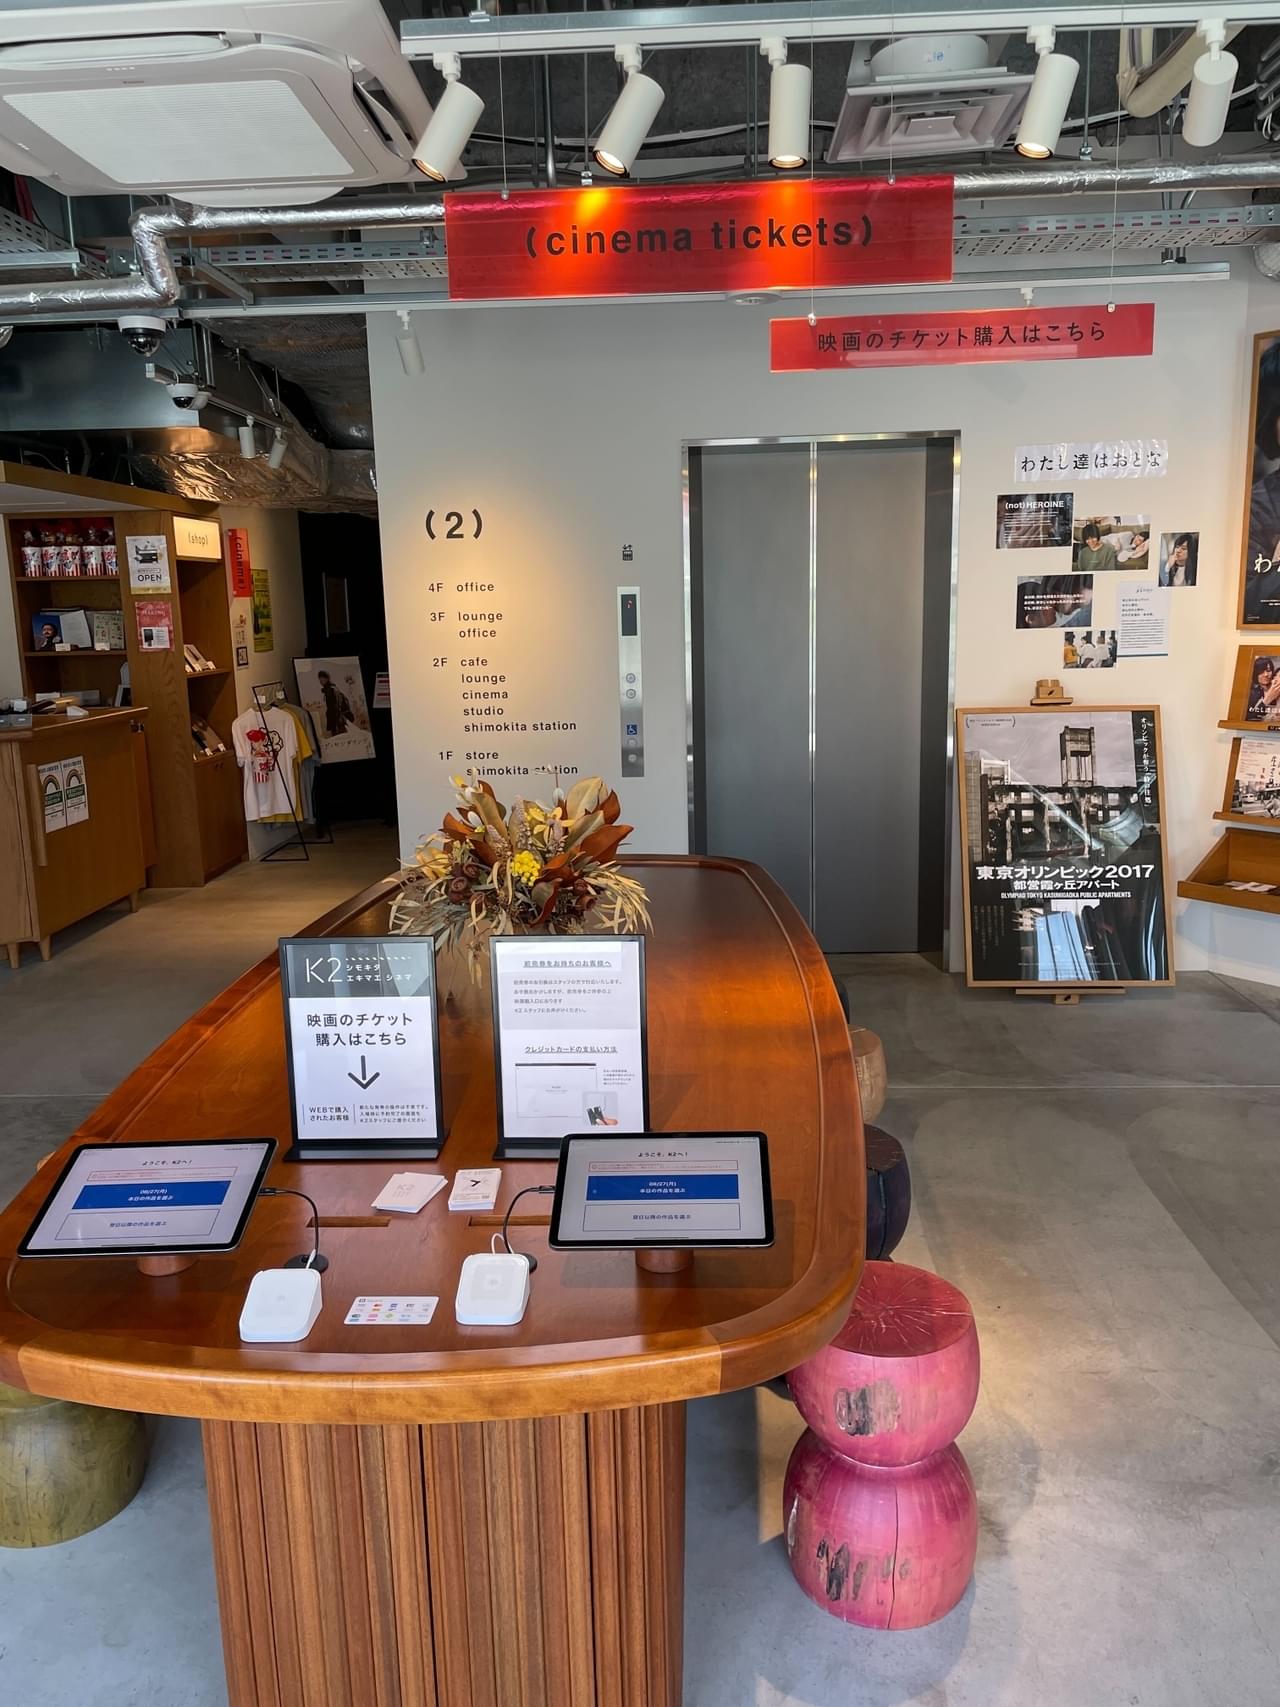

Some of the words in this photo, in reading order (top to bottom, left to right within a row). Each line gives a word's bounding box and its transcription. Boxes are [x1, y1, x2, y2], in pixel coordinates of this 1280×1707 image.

[525, 217, 694, 258] (cinema
[710, 215, 874, 251] tickets)
[817, 320, 1106, 352] 映画のチケット購入はこちら
[1021, 452, 1161, 473] わたし達はおとな
[1026, 501, 1065, 509] HEROINE
[188, 533, 209, 547] (shop)
[137, 574, 162, 582] OPEN
[428, 582, 444, 592] 4F
[456, 582, 495, 592] office
[430, 611, 445, 622] 3F
[458, 611, 503, 623] lounge
[459, 628, 497, 638] office
[433, 657, 448, 667] 2F
[460, 657, 488, 667] cafe
[461, 674, 506, 685] lounge
[462, 690, 509, 700] cinema
[463, 706, 504, 716] studio
[464, 722, 527, 732] shimokita
[532, 721, 577, 731] station
[439, 751, 453, 760] 1F
[465, 751, 499, 760] store
[976, 864, 1155, 881] 東京オリンピック2017
[1013, 880, 1120, 891] 都営霞ヶ丘アパート
[306, 957, 343, 983] K2
[346, 964, 381, 972] シモキタ
[346, 974, 381, 982] エキマエ
[307, 1012, 413, 1027] 映画のチケット
[316, 1032, 407, 1047] 購入はこちら
[309, 1106, 349, 1114] WEBで購入
[310, 1114, 349, 1122] されたお客様
